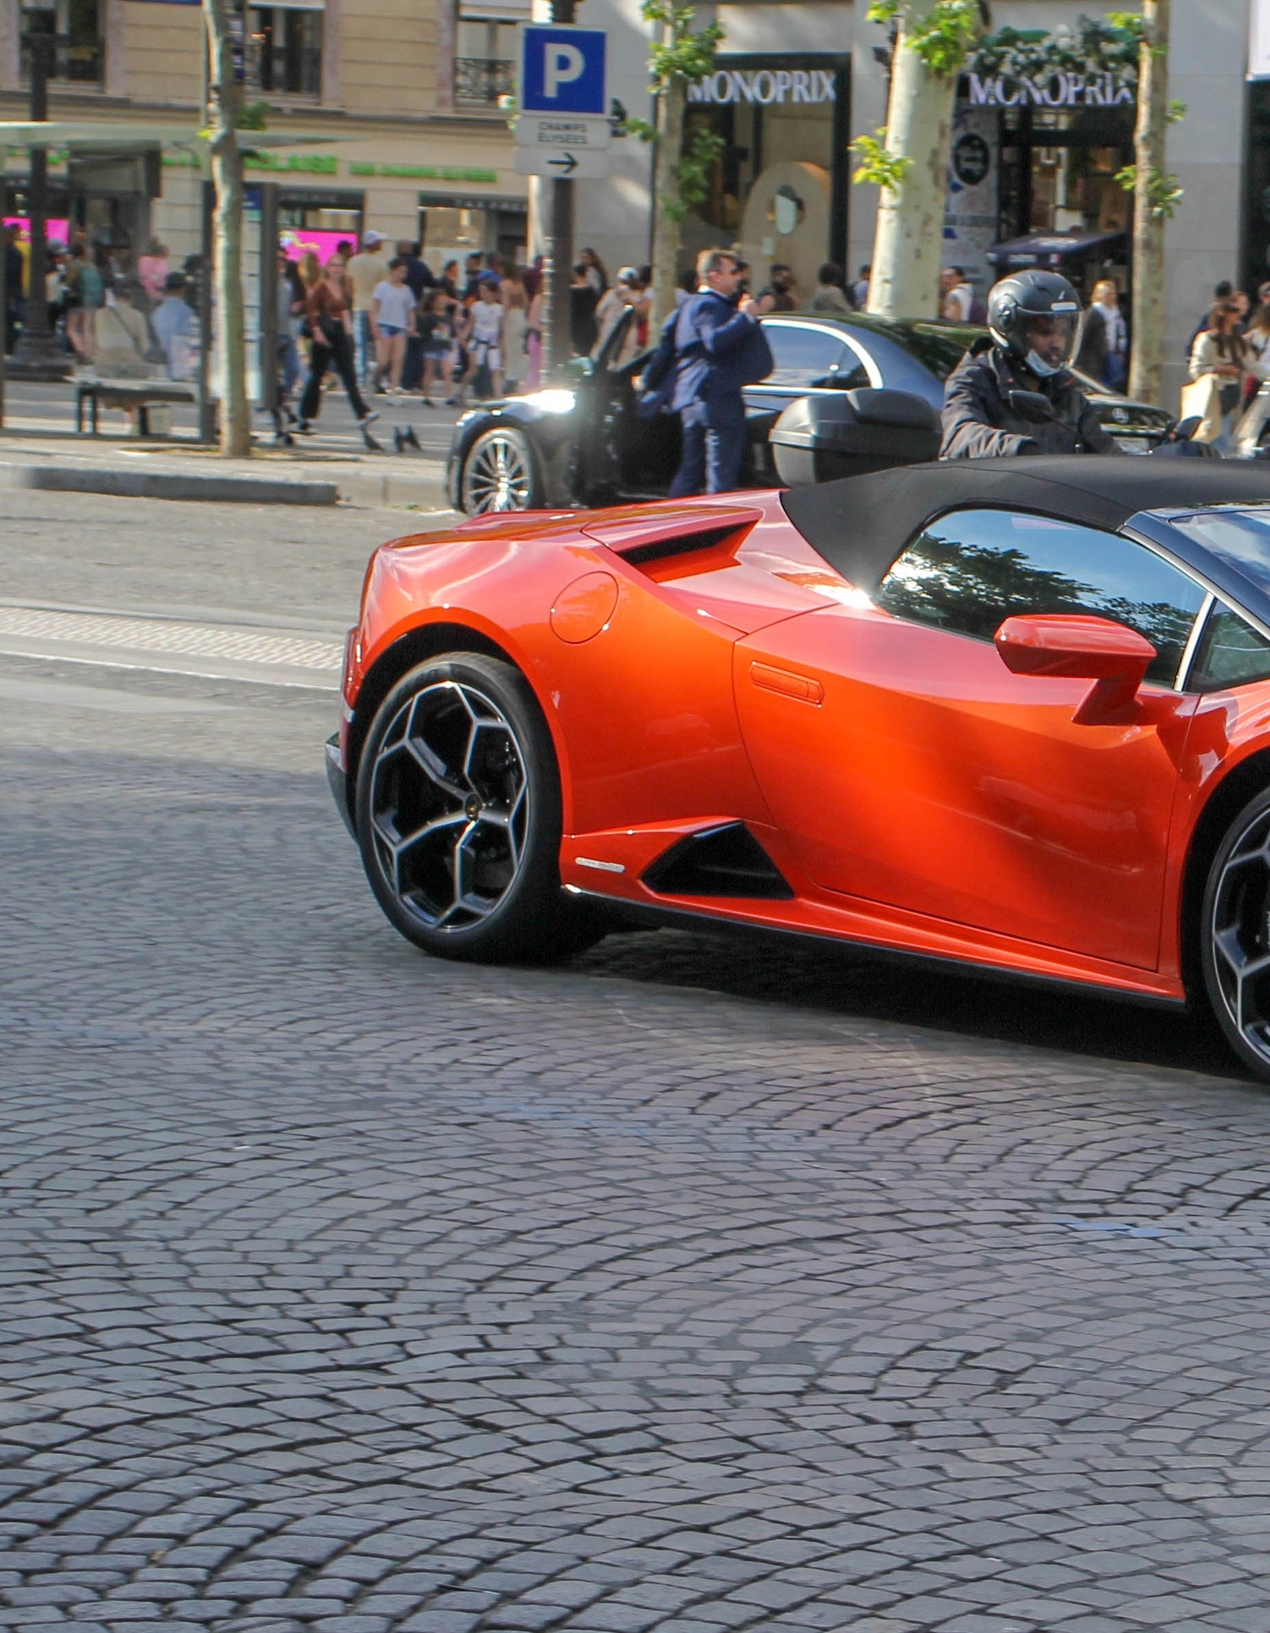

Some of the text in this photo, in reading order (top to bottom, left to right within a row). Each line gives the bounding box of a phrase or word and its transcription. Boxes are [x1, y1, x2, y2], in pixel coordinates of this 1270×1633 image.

[543, 42, 586, 98] P
[687, 69, 837, 104] MONOPRIX
[537, 121, 587, 133] CHAMPS
